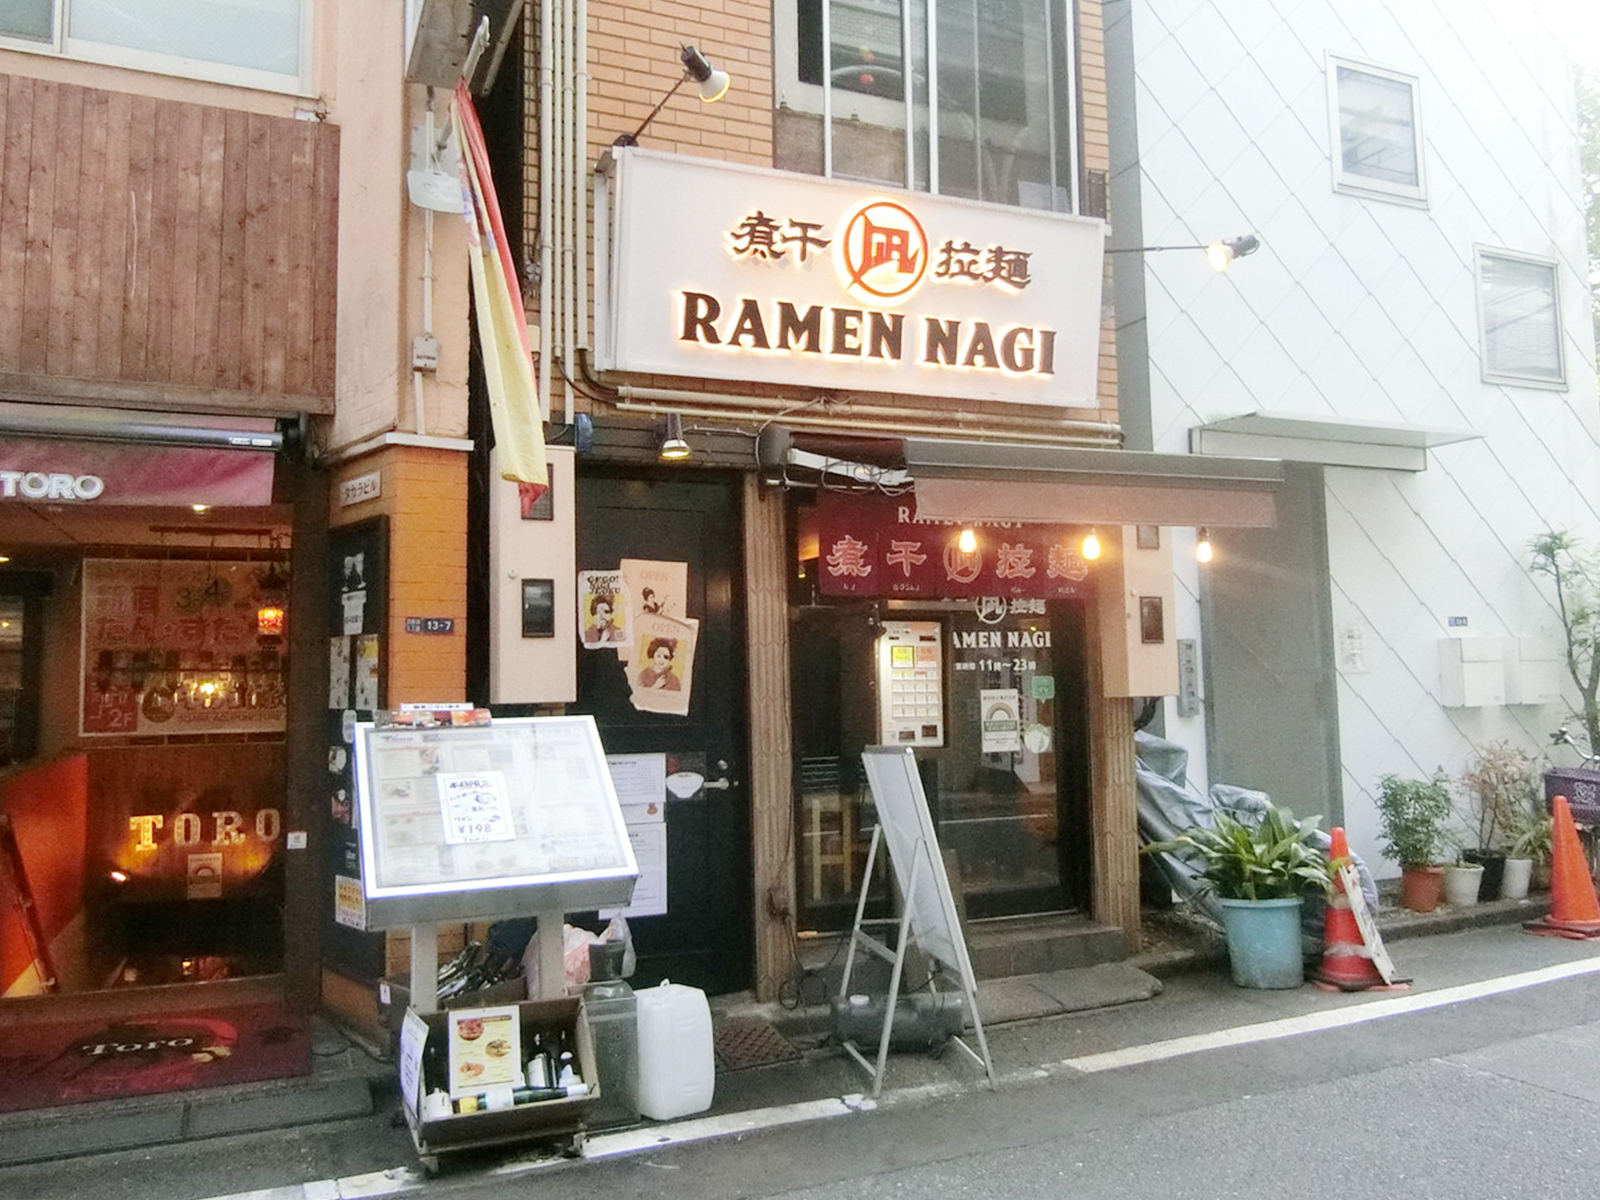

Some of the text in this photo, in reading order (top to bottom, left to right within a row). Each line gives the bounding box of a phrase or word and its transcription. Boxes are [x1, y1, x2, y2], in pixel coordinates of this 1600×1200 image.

[679, 291, 1057, 376] RAMEN NAGI
[0, 470, 105, 500] TORO
[640, 570, 668, 581] OPEN
[427, 620, 452, 631] 13-7
[652, 622, 681, 633] OPEN
[1008, 630, 1051, 648] NAGI
[129, 808, 281, 851] TORO
[83, 1038, 193, 1056] Toro
